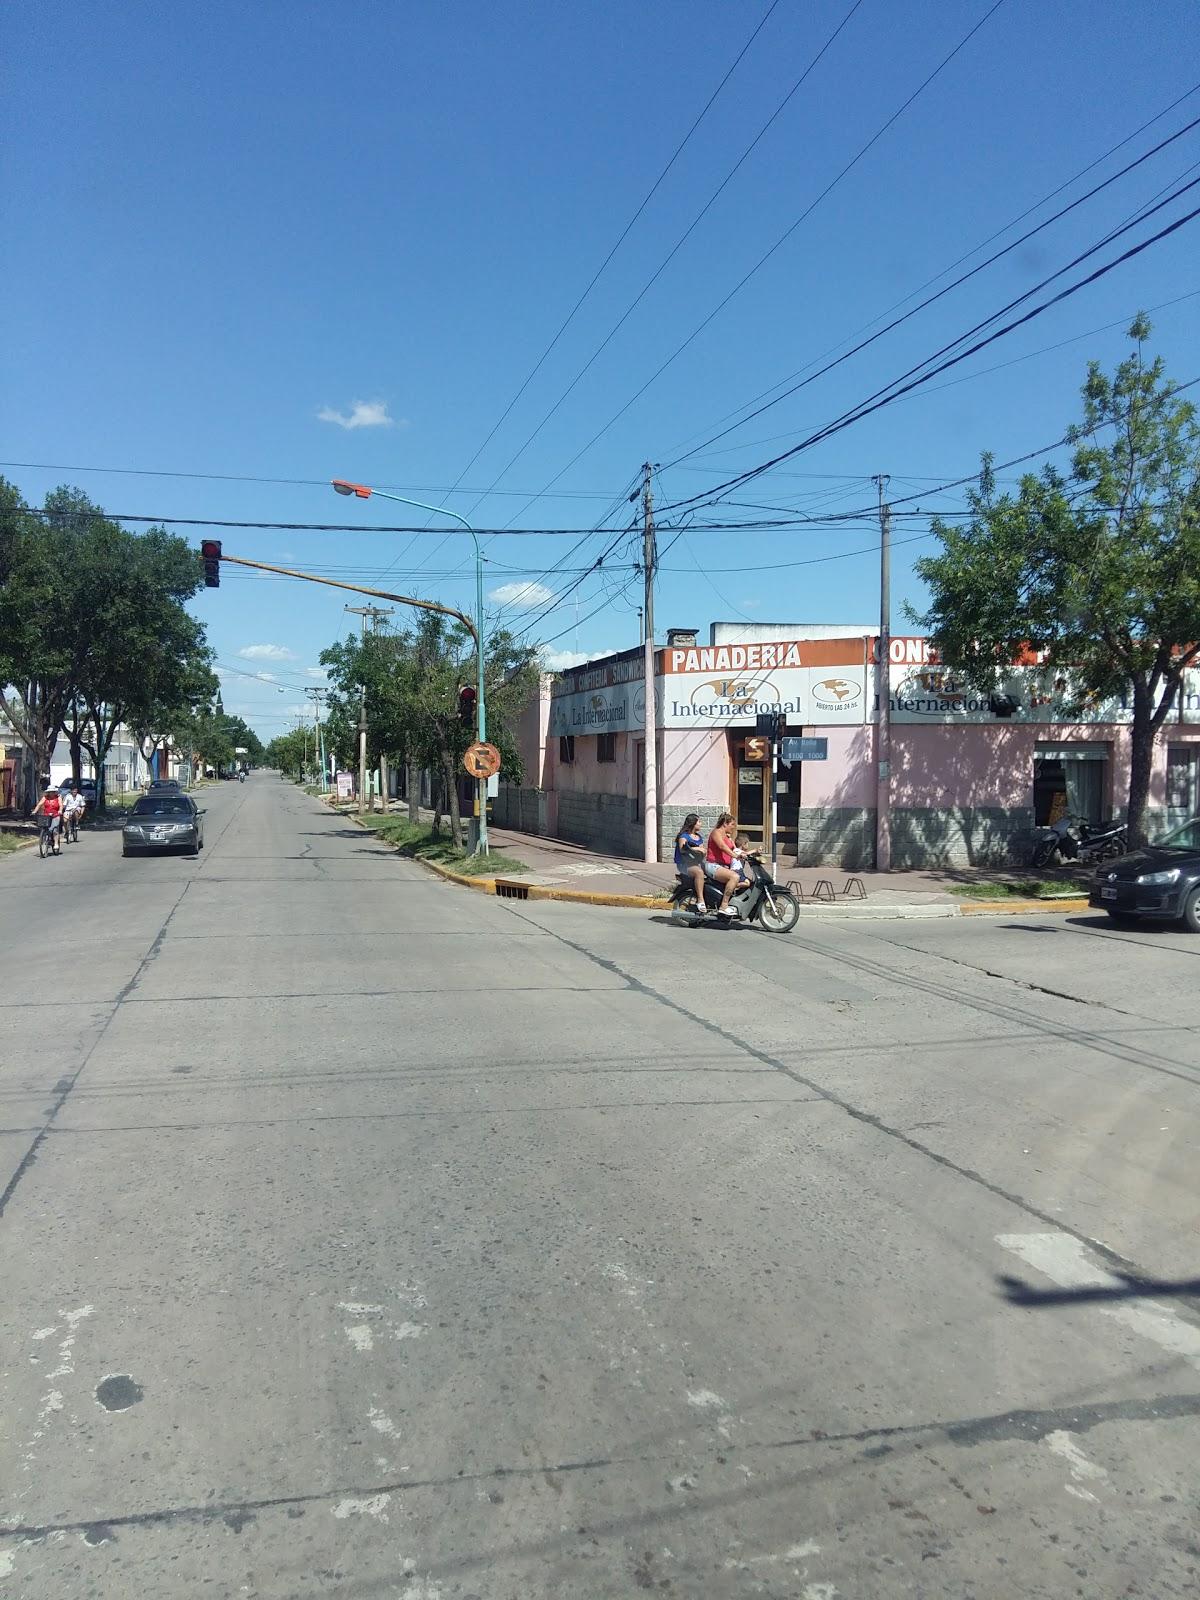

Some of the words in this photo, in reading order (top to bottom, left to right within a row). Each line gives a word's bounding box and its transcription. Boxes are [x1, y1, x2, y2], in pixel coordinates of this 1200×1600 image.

[672, 644, 801, 671] PANADERIA
[720, 681, 748, 697] La
[929, 672, 957, 693] La
[572, 708, 581, 726] La
[582, 700, 626, 724] Internacional
[672, 697, 802, 716] Internacional
[816, 702, 833, 711] ABIERTO
